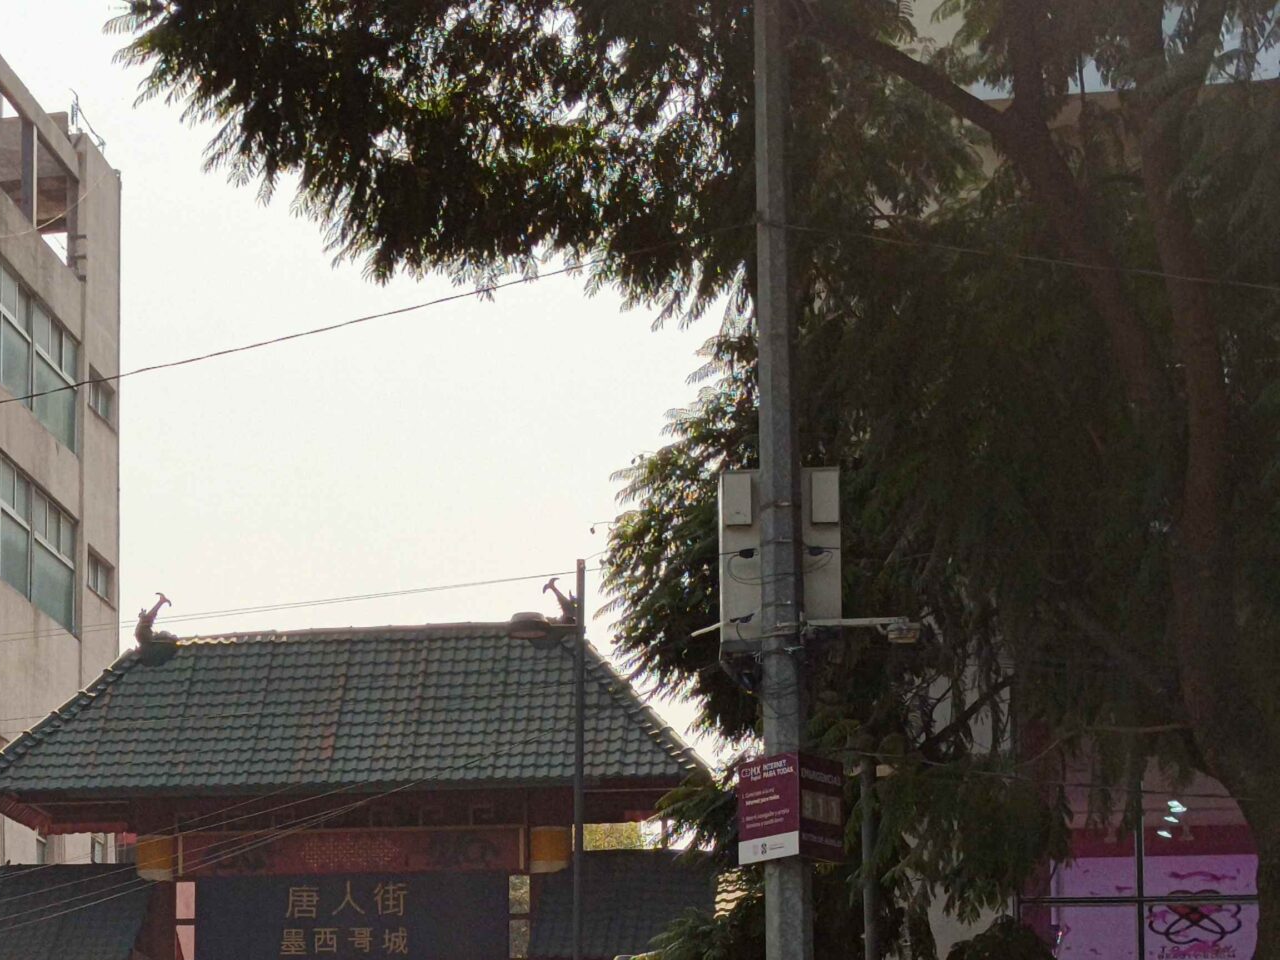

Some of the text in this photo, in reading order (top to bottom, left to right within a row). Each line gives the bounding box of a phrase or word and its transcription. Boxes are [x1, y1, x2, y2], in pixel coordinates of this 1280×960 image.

[285, 880, 409, 919] 唐人街
[280, 927, 409, 955] 墨西哥城
